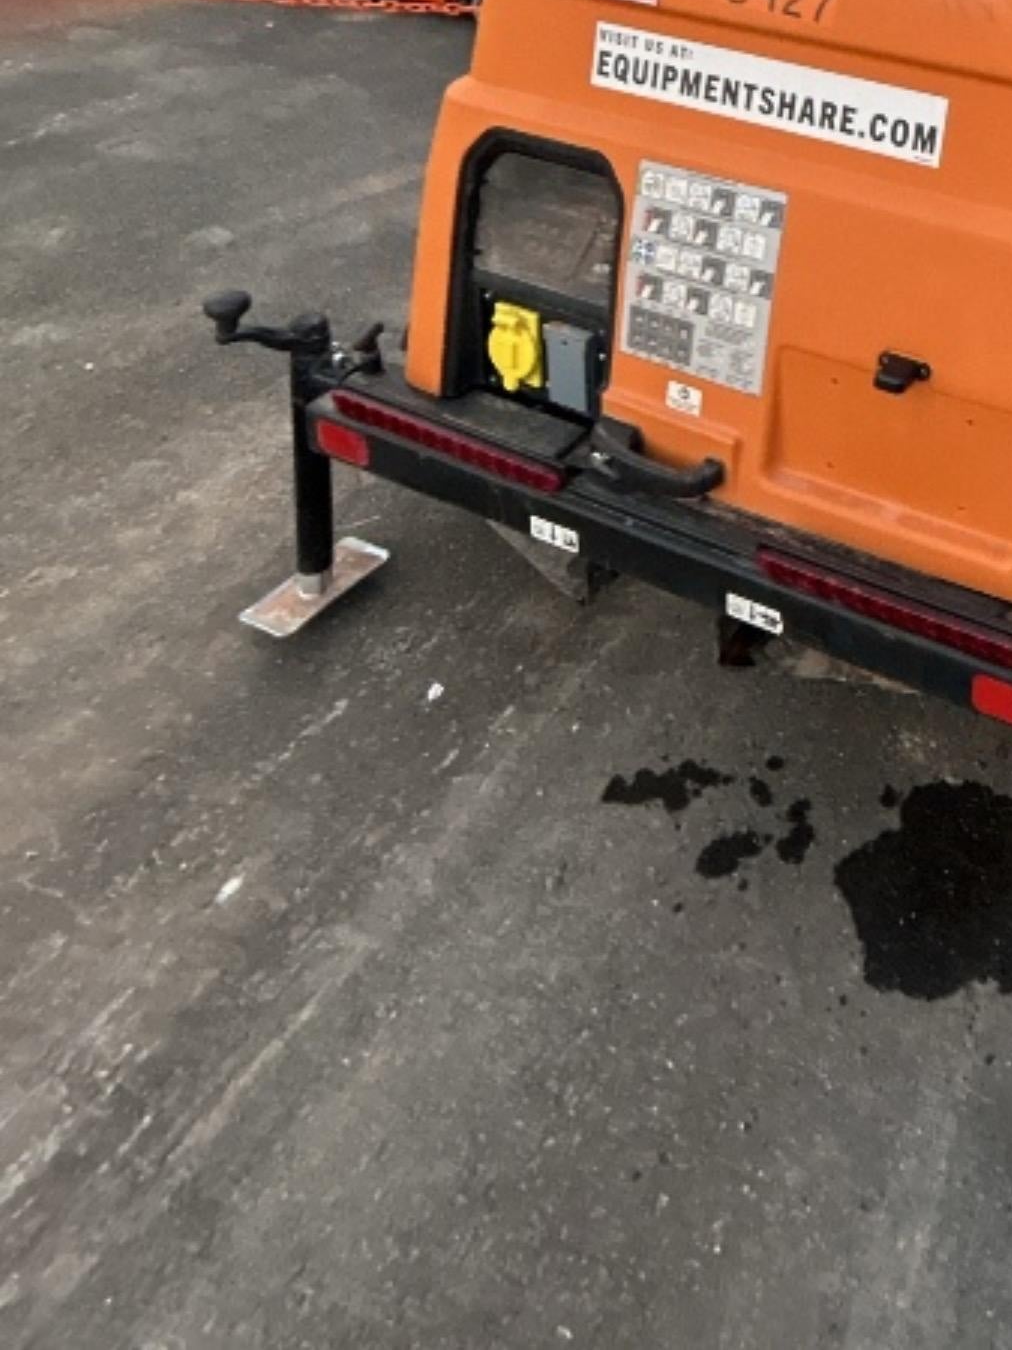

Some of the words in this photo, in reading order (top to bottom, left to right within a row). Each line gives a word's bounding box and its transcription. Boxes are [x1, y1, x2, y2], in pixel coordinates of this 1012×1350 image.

[600, 28, 639, 50] VISIT
[644, 38, 664, 55] US
[596, 49, 938, 156] EQUIPMENTSHARE.COM
